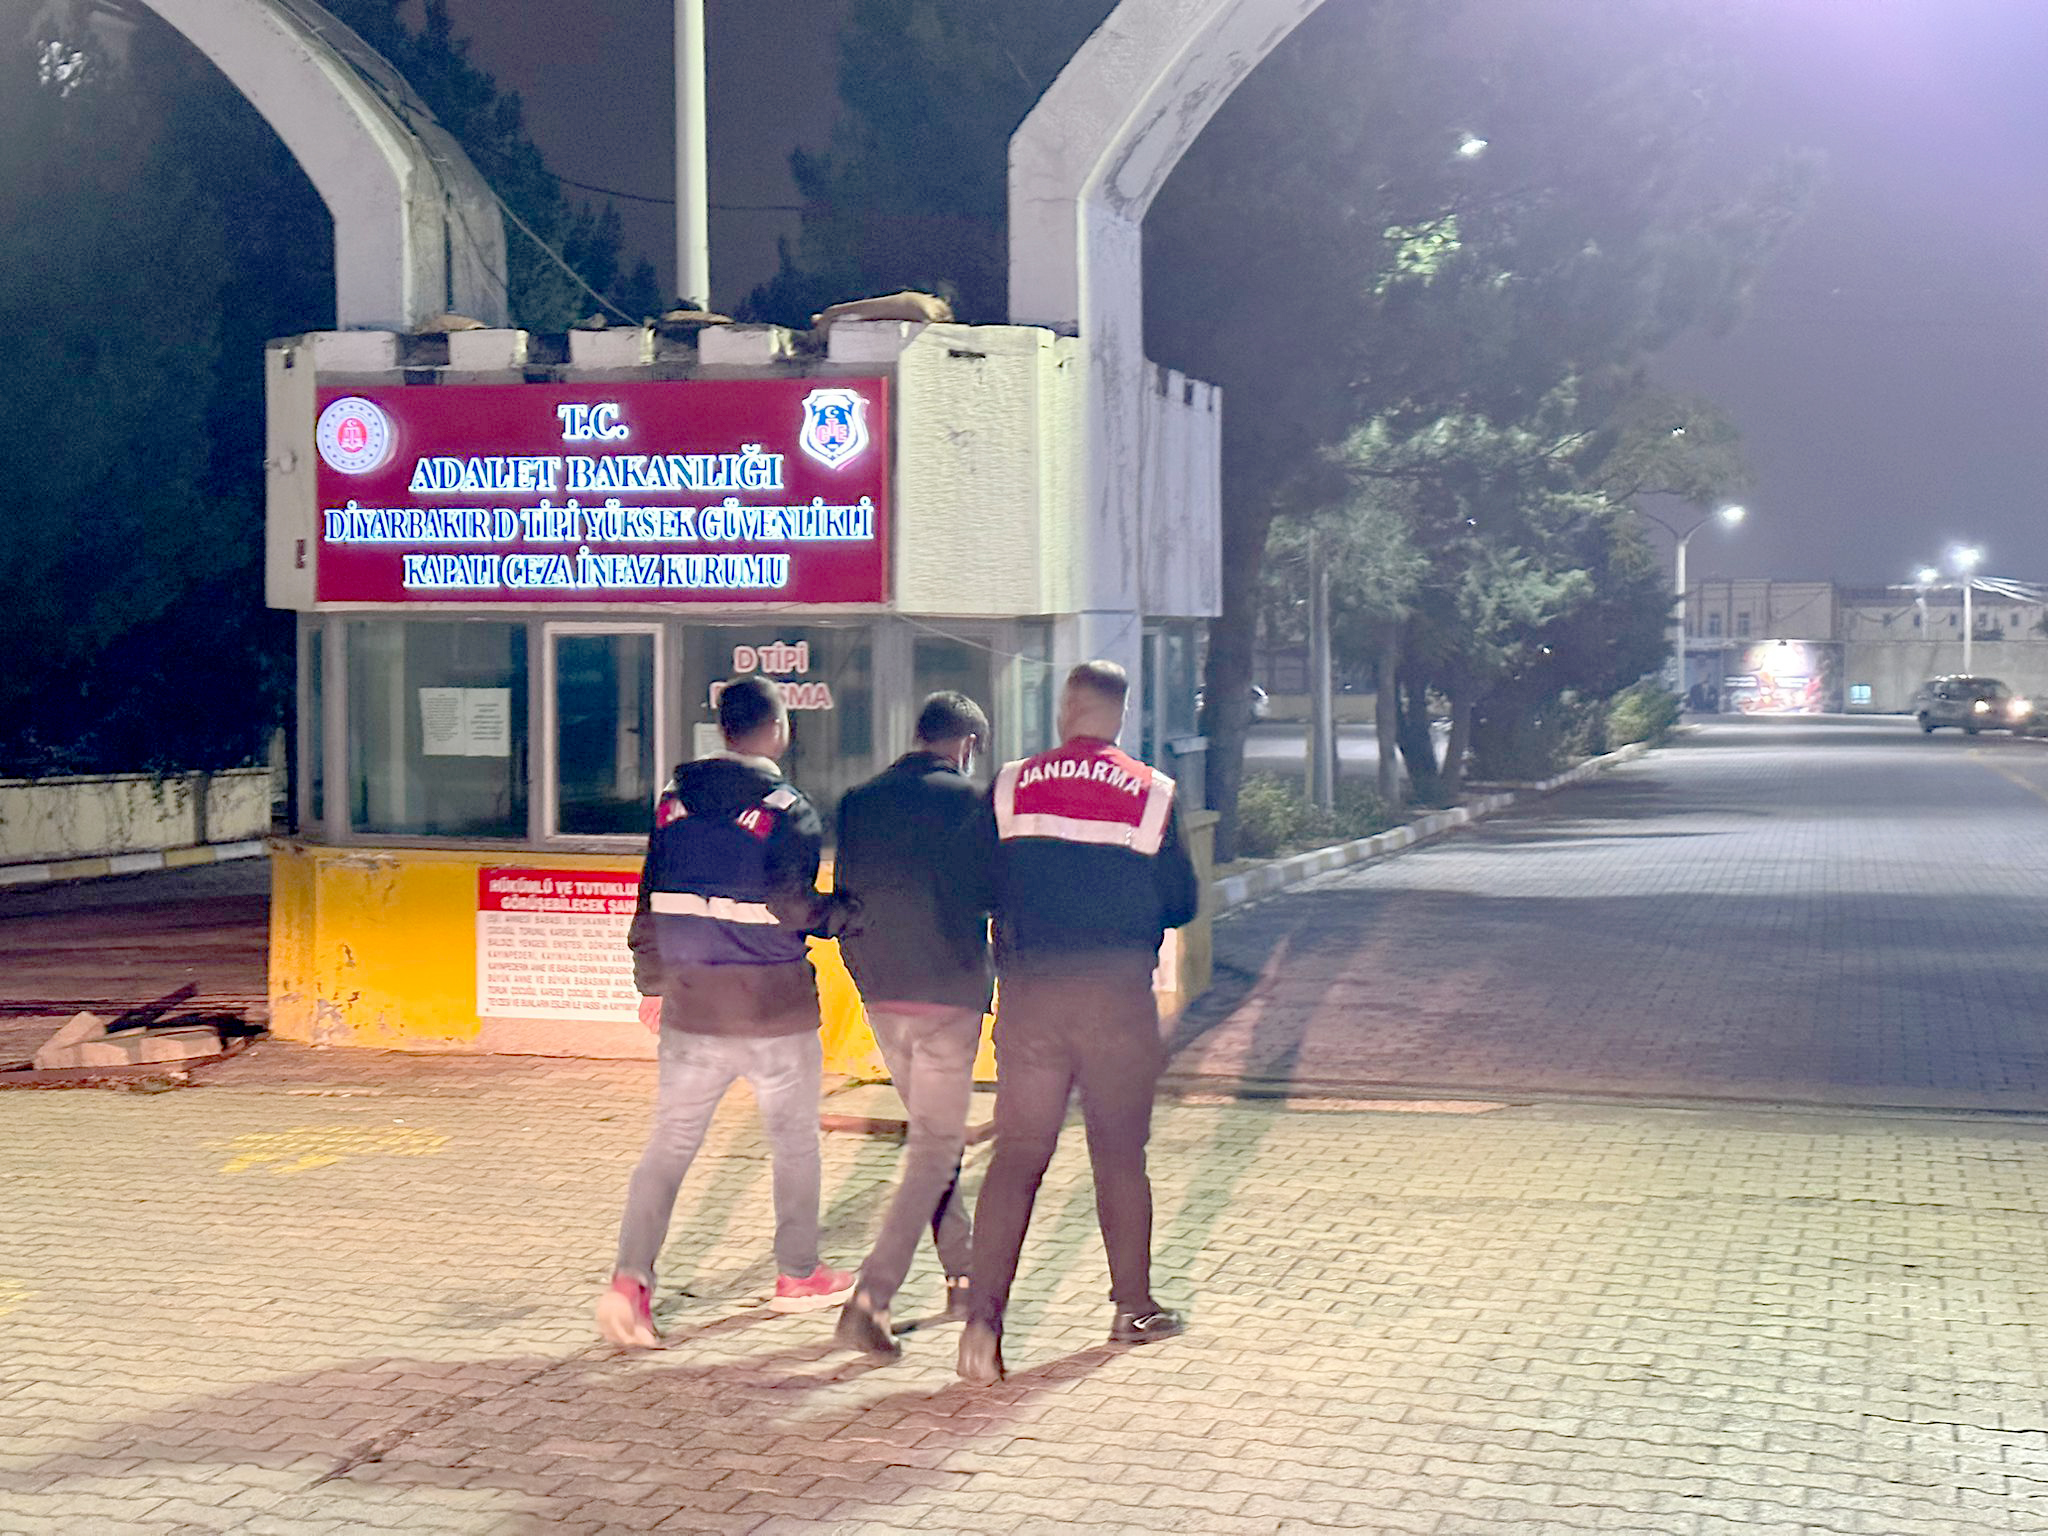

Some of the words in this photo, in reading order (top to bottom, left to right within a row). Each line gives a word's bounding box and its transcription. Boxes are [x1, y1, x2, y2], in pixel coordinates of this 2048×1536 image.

[558, 403, 629, 440] T.C.
[409, 455, 559, 491] ADALET
[566, 444, 784, 490] BAKANLIĞI
[324, 500, 489, 542] DİYARBAKIR
[493, 508, 517, 541] D
[521, 499, 581, 540] TİPİ
[585, 499, 698, 540] YÜKSEK
[700, 496, 873, 540] GÜVENLİKLİ
[403, 553, 501, 588] KAPALI
[502, 553, 574, 588] CEZA
[577, 545, 662, 588] İNFAZ
[663, 553, 789, 588] KURUMU
[734, 646, 757, 673] D
[758, 641, 809, 674] TİPİ
[1018, 759, 1145, 797] JANDARMA
